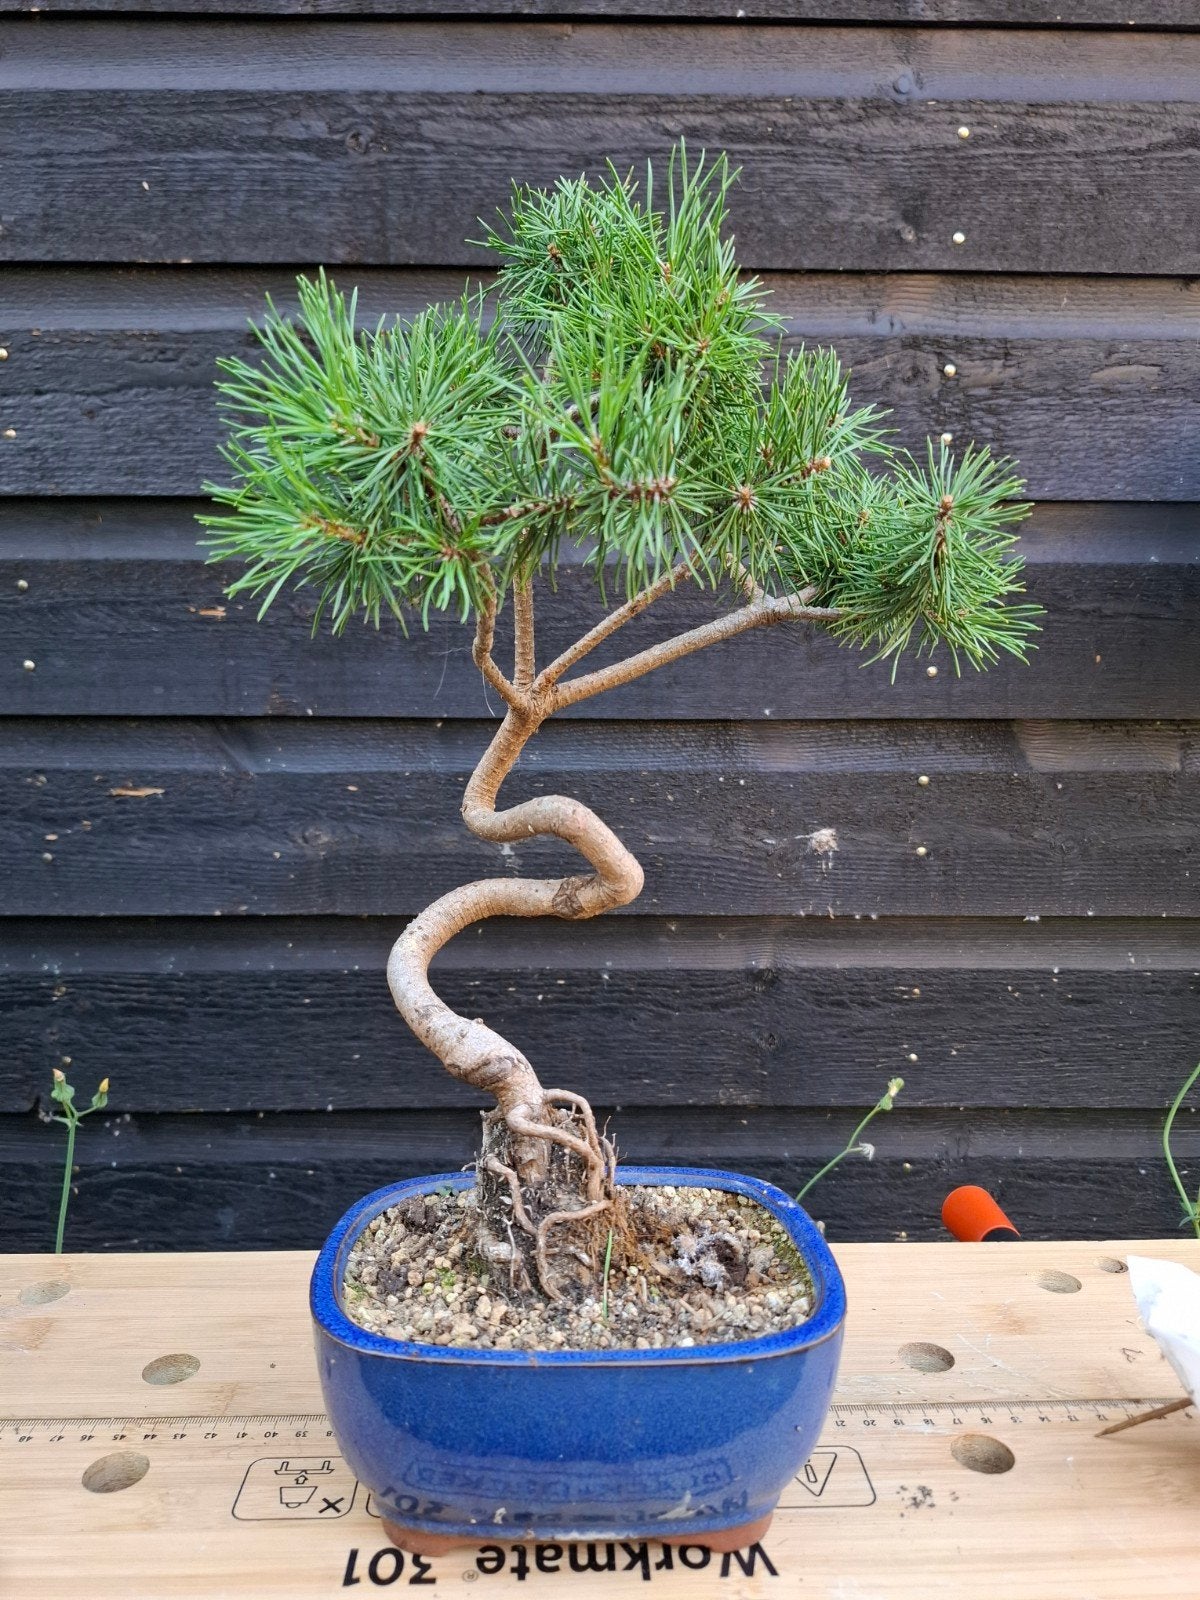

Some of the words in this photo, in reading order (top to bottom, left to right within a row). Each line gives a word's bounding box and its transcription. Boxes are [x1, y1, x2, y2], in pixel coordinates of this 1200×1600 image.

[923, 1418, 935, 1426] 18
[172, 1432, 187, 1440] 43
[203, 1432, 218, 1440] 42
[295, 1430, 309, 1438] 39
[18, 1435, 34, 1443] 48
[342, 1547, 437, 1586] 301
